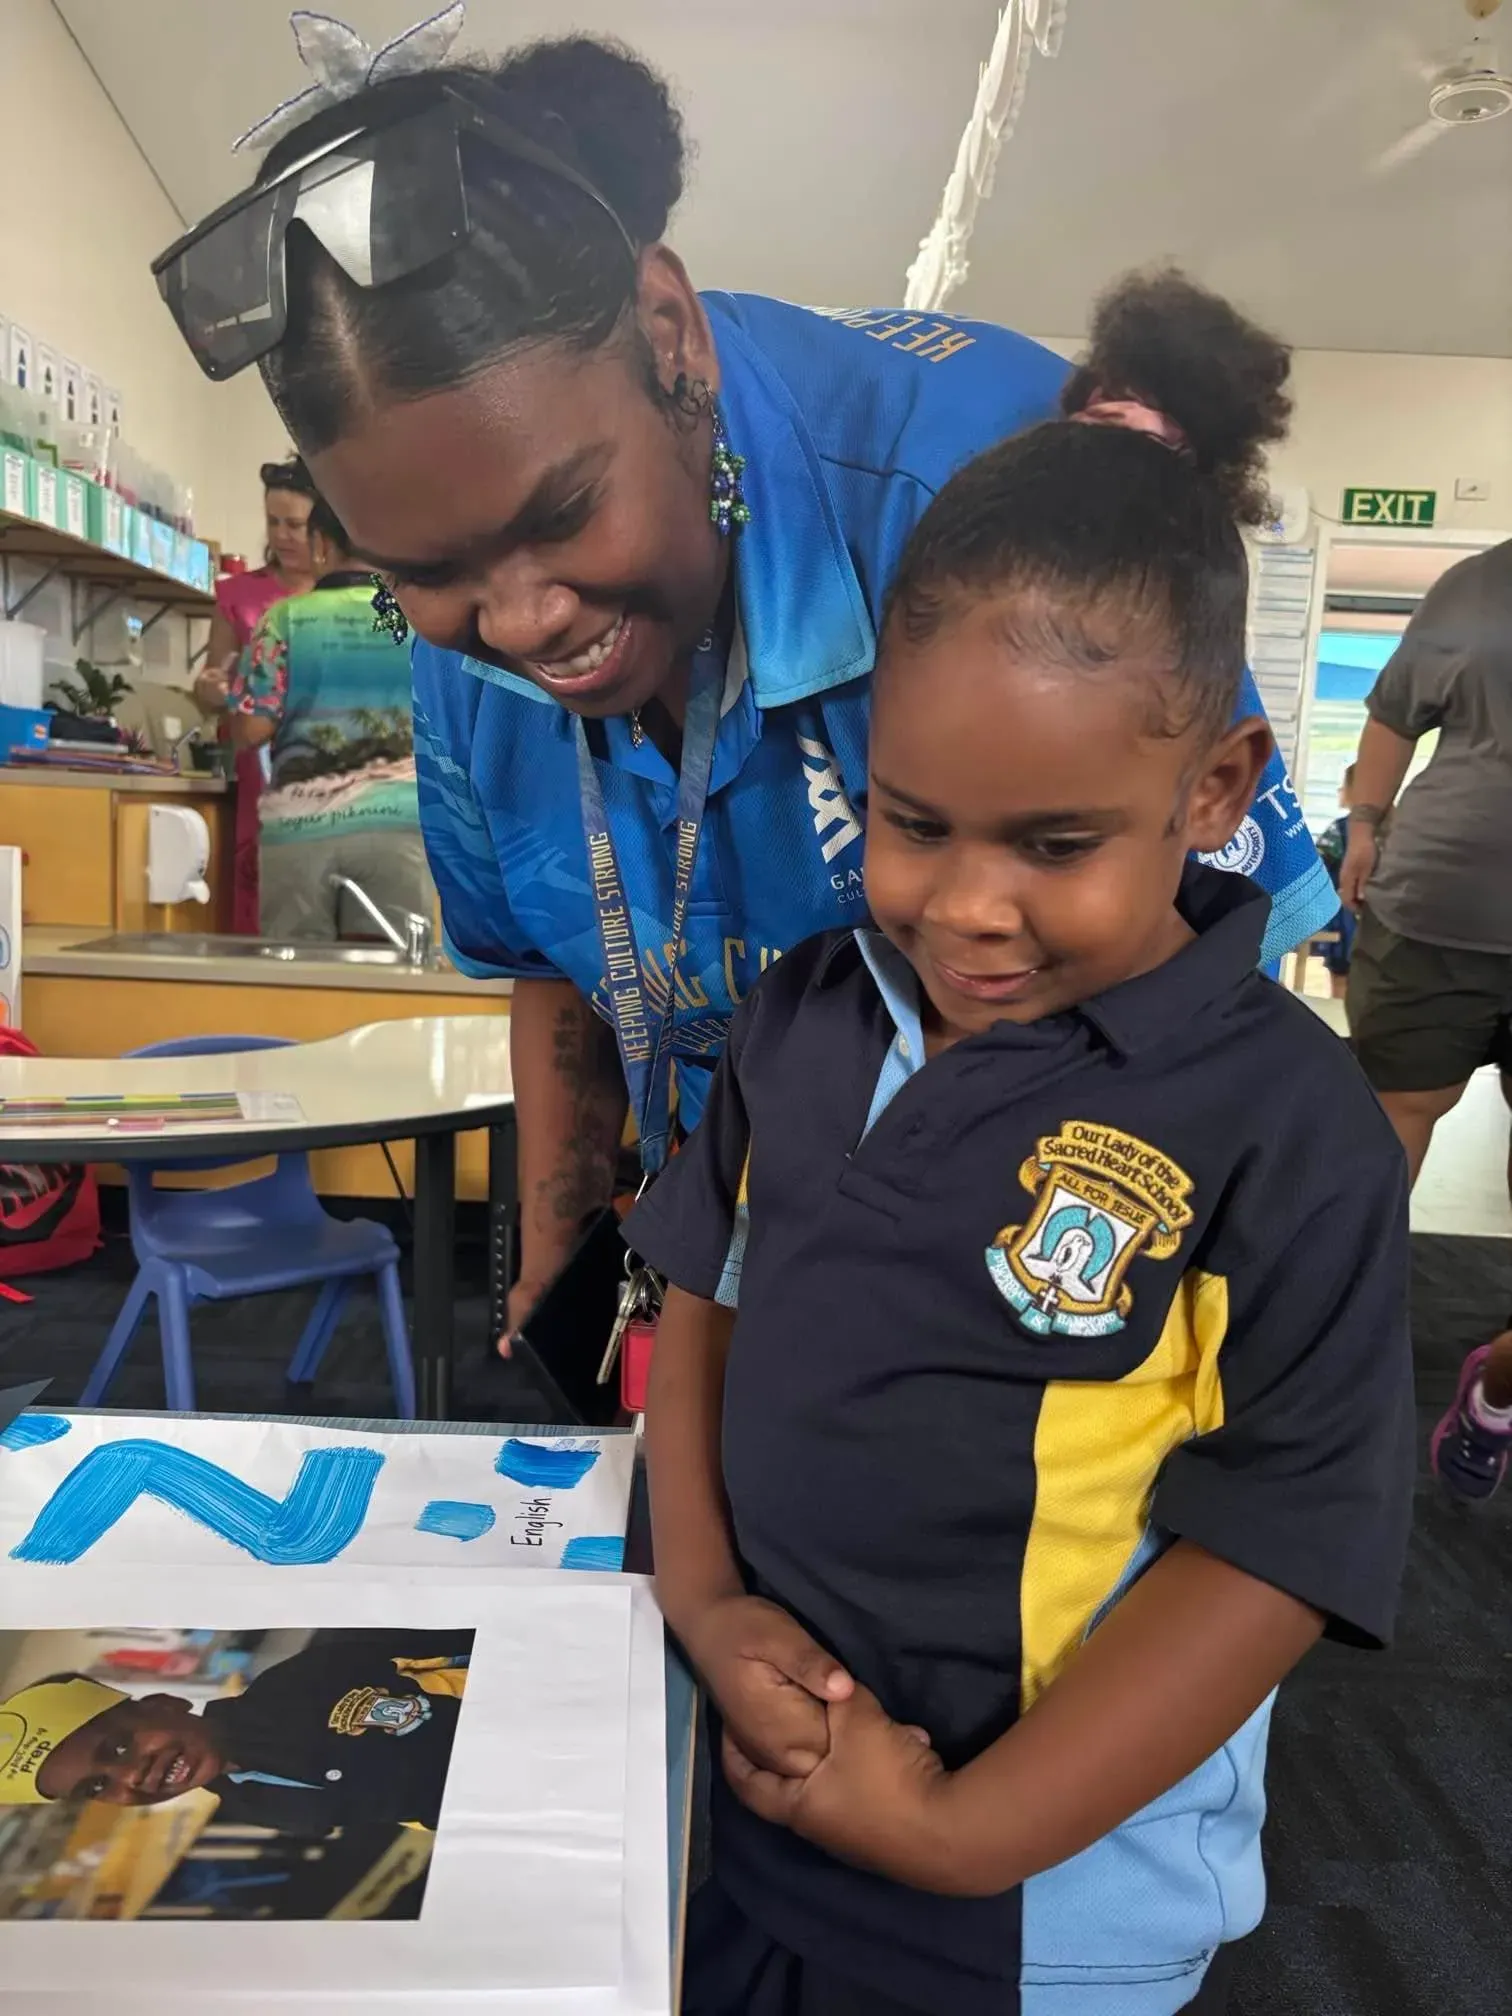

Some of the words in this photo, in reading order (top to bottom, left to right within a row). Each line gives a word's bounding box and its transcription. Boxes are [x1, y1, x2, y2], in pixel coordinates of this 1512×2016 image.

[1351, 492, 1429, 524] EXIT
[590, 832, 621, 901] STRONG
[676, 820, 698, 892] STRONG
[600, 906, 637, 982] CULTURE
[614, 987, 651, 1063] KEEPING
[1043, 1139, 1097, 1164] Sacred
[1099, 1149, 1142, 1184] Heart
[1139, 1173, 1188, 1222] School
[1072, 1126, 1104, 1144] Our
[1101, 1133, 1140, 1162] Lady
[1138, 1153, 1161, 1168] of
[1155, 1161, 1180, 1190] the
[1056, 1173, 1081, 1192] ALL
[1083, 1184, 1109, 1204] FOR
[1111, 1200, 1147, 1224] JESUS
[511, 1498, 563, 1546] English
